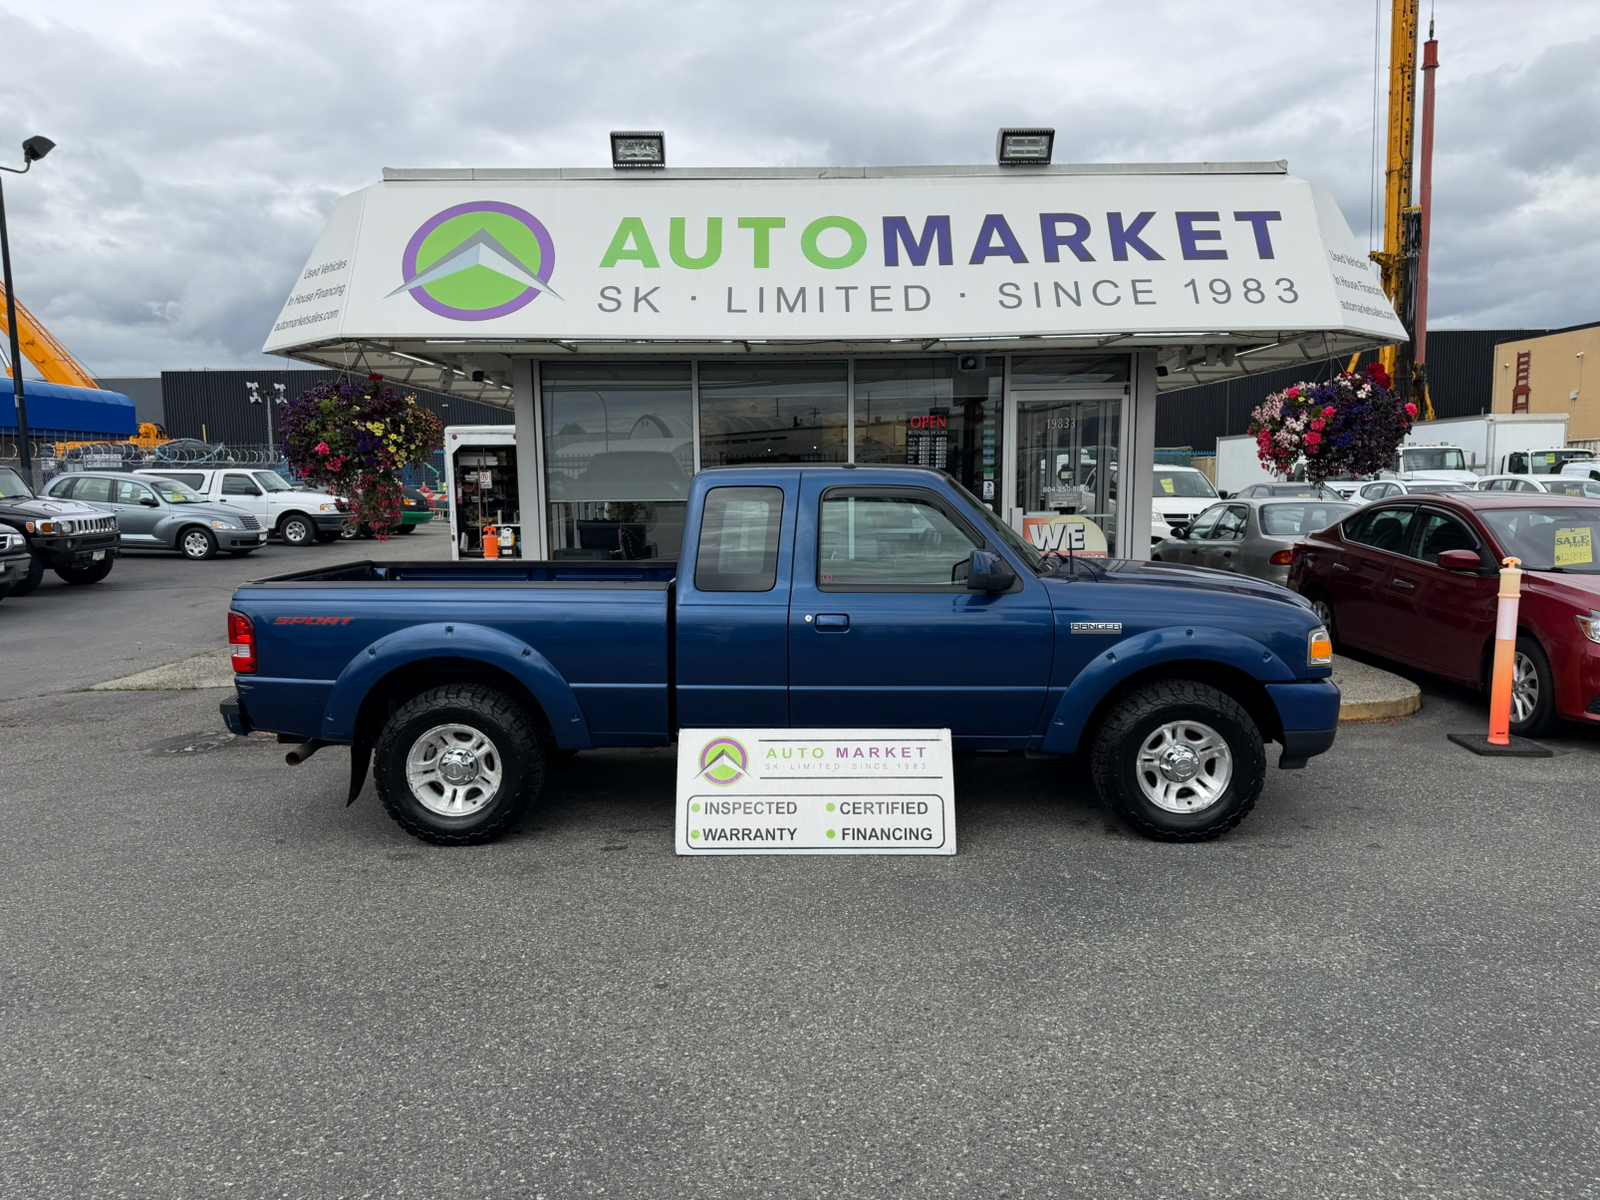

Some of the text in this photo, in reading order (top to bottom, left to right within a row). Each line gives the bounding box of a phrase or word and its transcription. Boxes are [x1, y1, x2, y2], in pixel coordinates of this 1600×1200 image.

[1329, 250, 1368, 270] Used Vehicles
[304, 259, 348, 279] Used Vehicles
[1333, 274, 1385, 299] In House Financing
[287, 284, 346, 307] In House Financing
[598, 277, 1299, 313] SK LIMITED SINCE 1983
[1340, 300, 1397, 320] automarketsales.com
[274, 309, 339, 331] automarketsales.com
[910, 416, 946, 428] OPEN
[1046, 418, 1076, 429] 19833
[1029, 522, 1085, 551] WE
[1556, 535, 1590, 546] SALE
[273, 617, 356, 626] SPORT
[766, 747, 928, 759] AUTO MARKET
[704, 802, 798, 815] INSPECTED
[840, 801, 928, 815] CERTIFIED
[702, 827, 798, 841] WARRANTY
[841, 827, 933, 841] FINANCING
